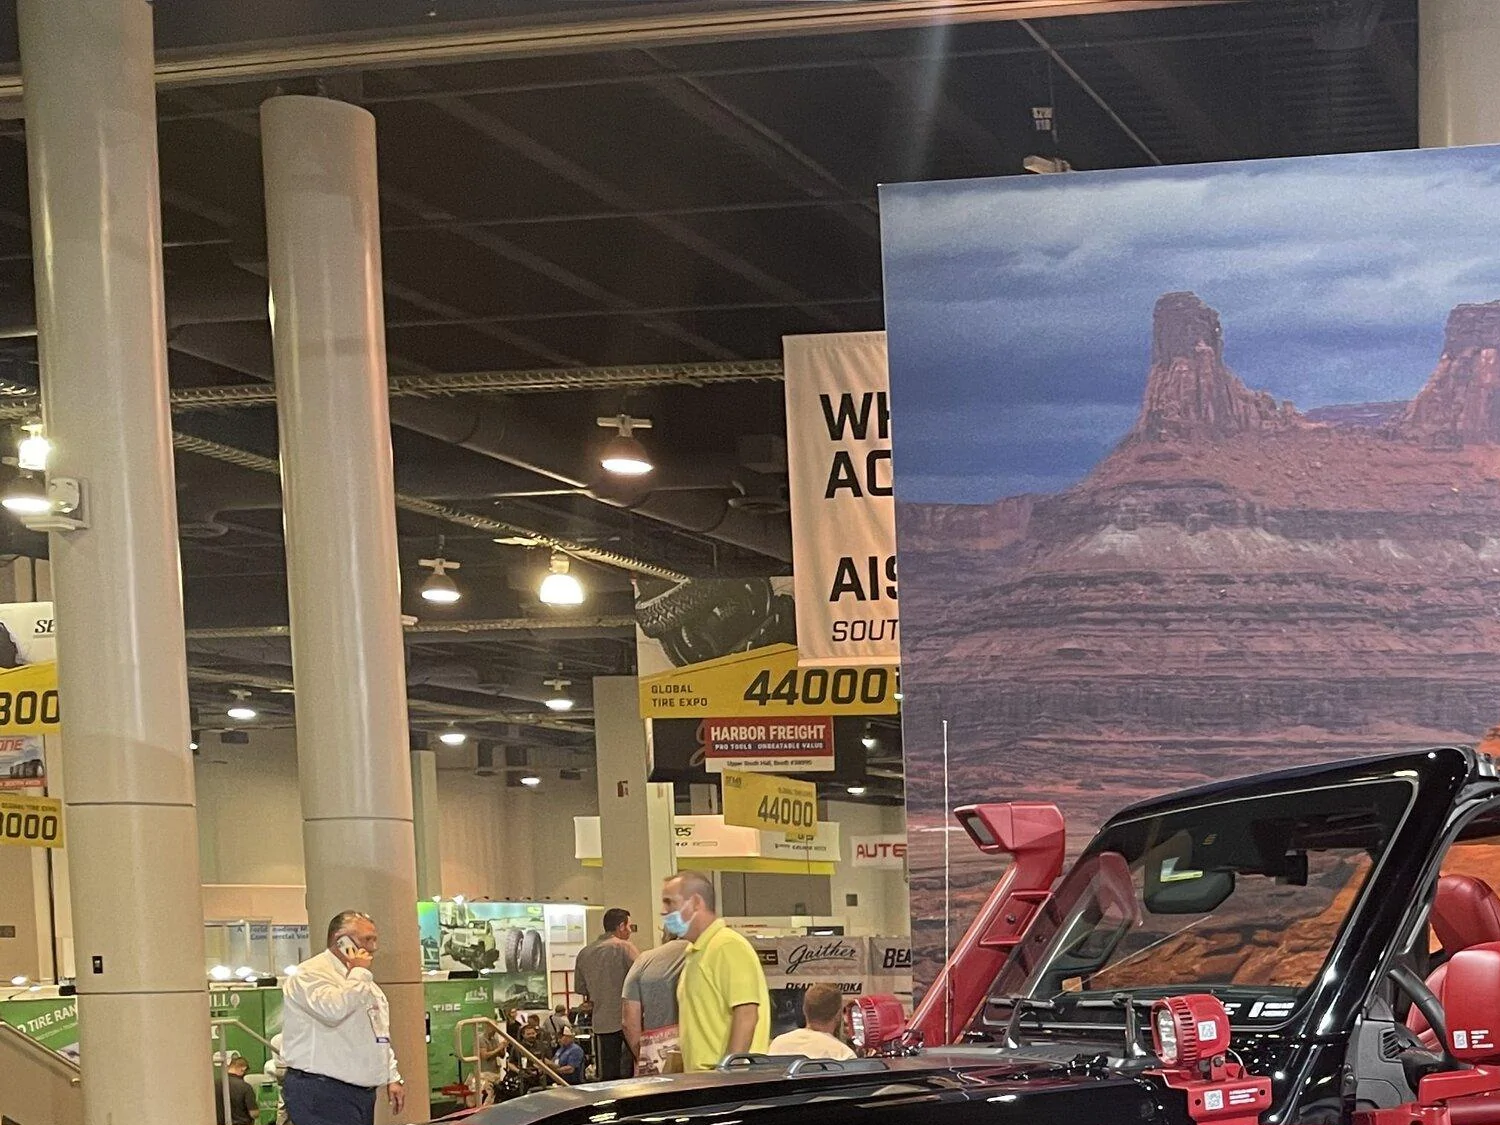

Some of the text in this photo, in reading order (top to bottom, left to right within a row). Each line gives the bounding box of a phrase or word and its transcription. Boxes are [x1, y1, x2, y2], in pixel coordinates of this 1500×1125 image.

[651, 684, 694, 695] GLOBAL
[743, 668, 889, 706] 44000
[652, 697, 708, 708] TIRE EXPO
[710, 724, 826, 741] HARBOR FREIGHT
[758, 795, 813, 828] 44000
[0, 812, 58, 841] 000
[27, 1013, 54, 1032] TIRE
